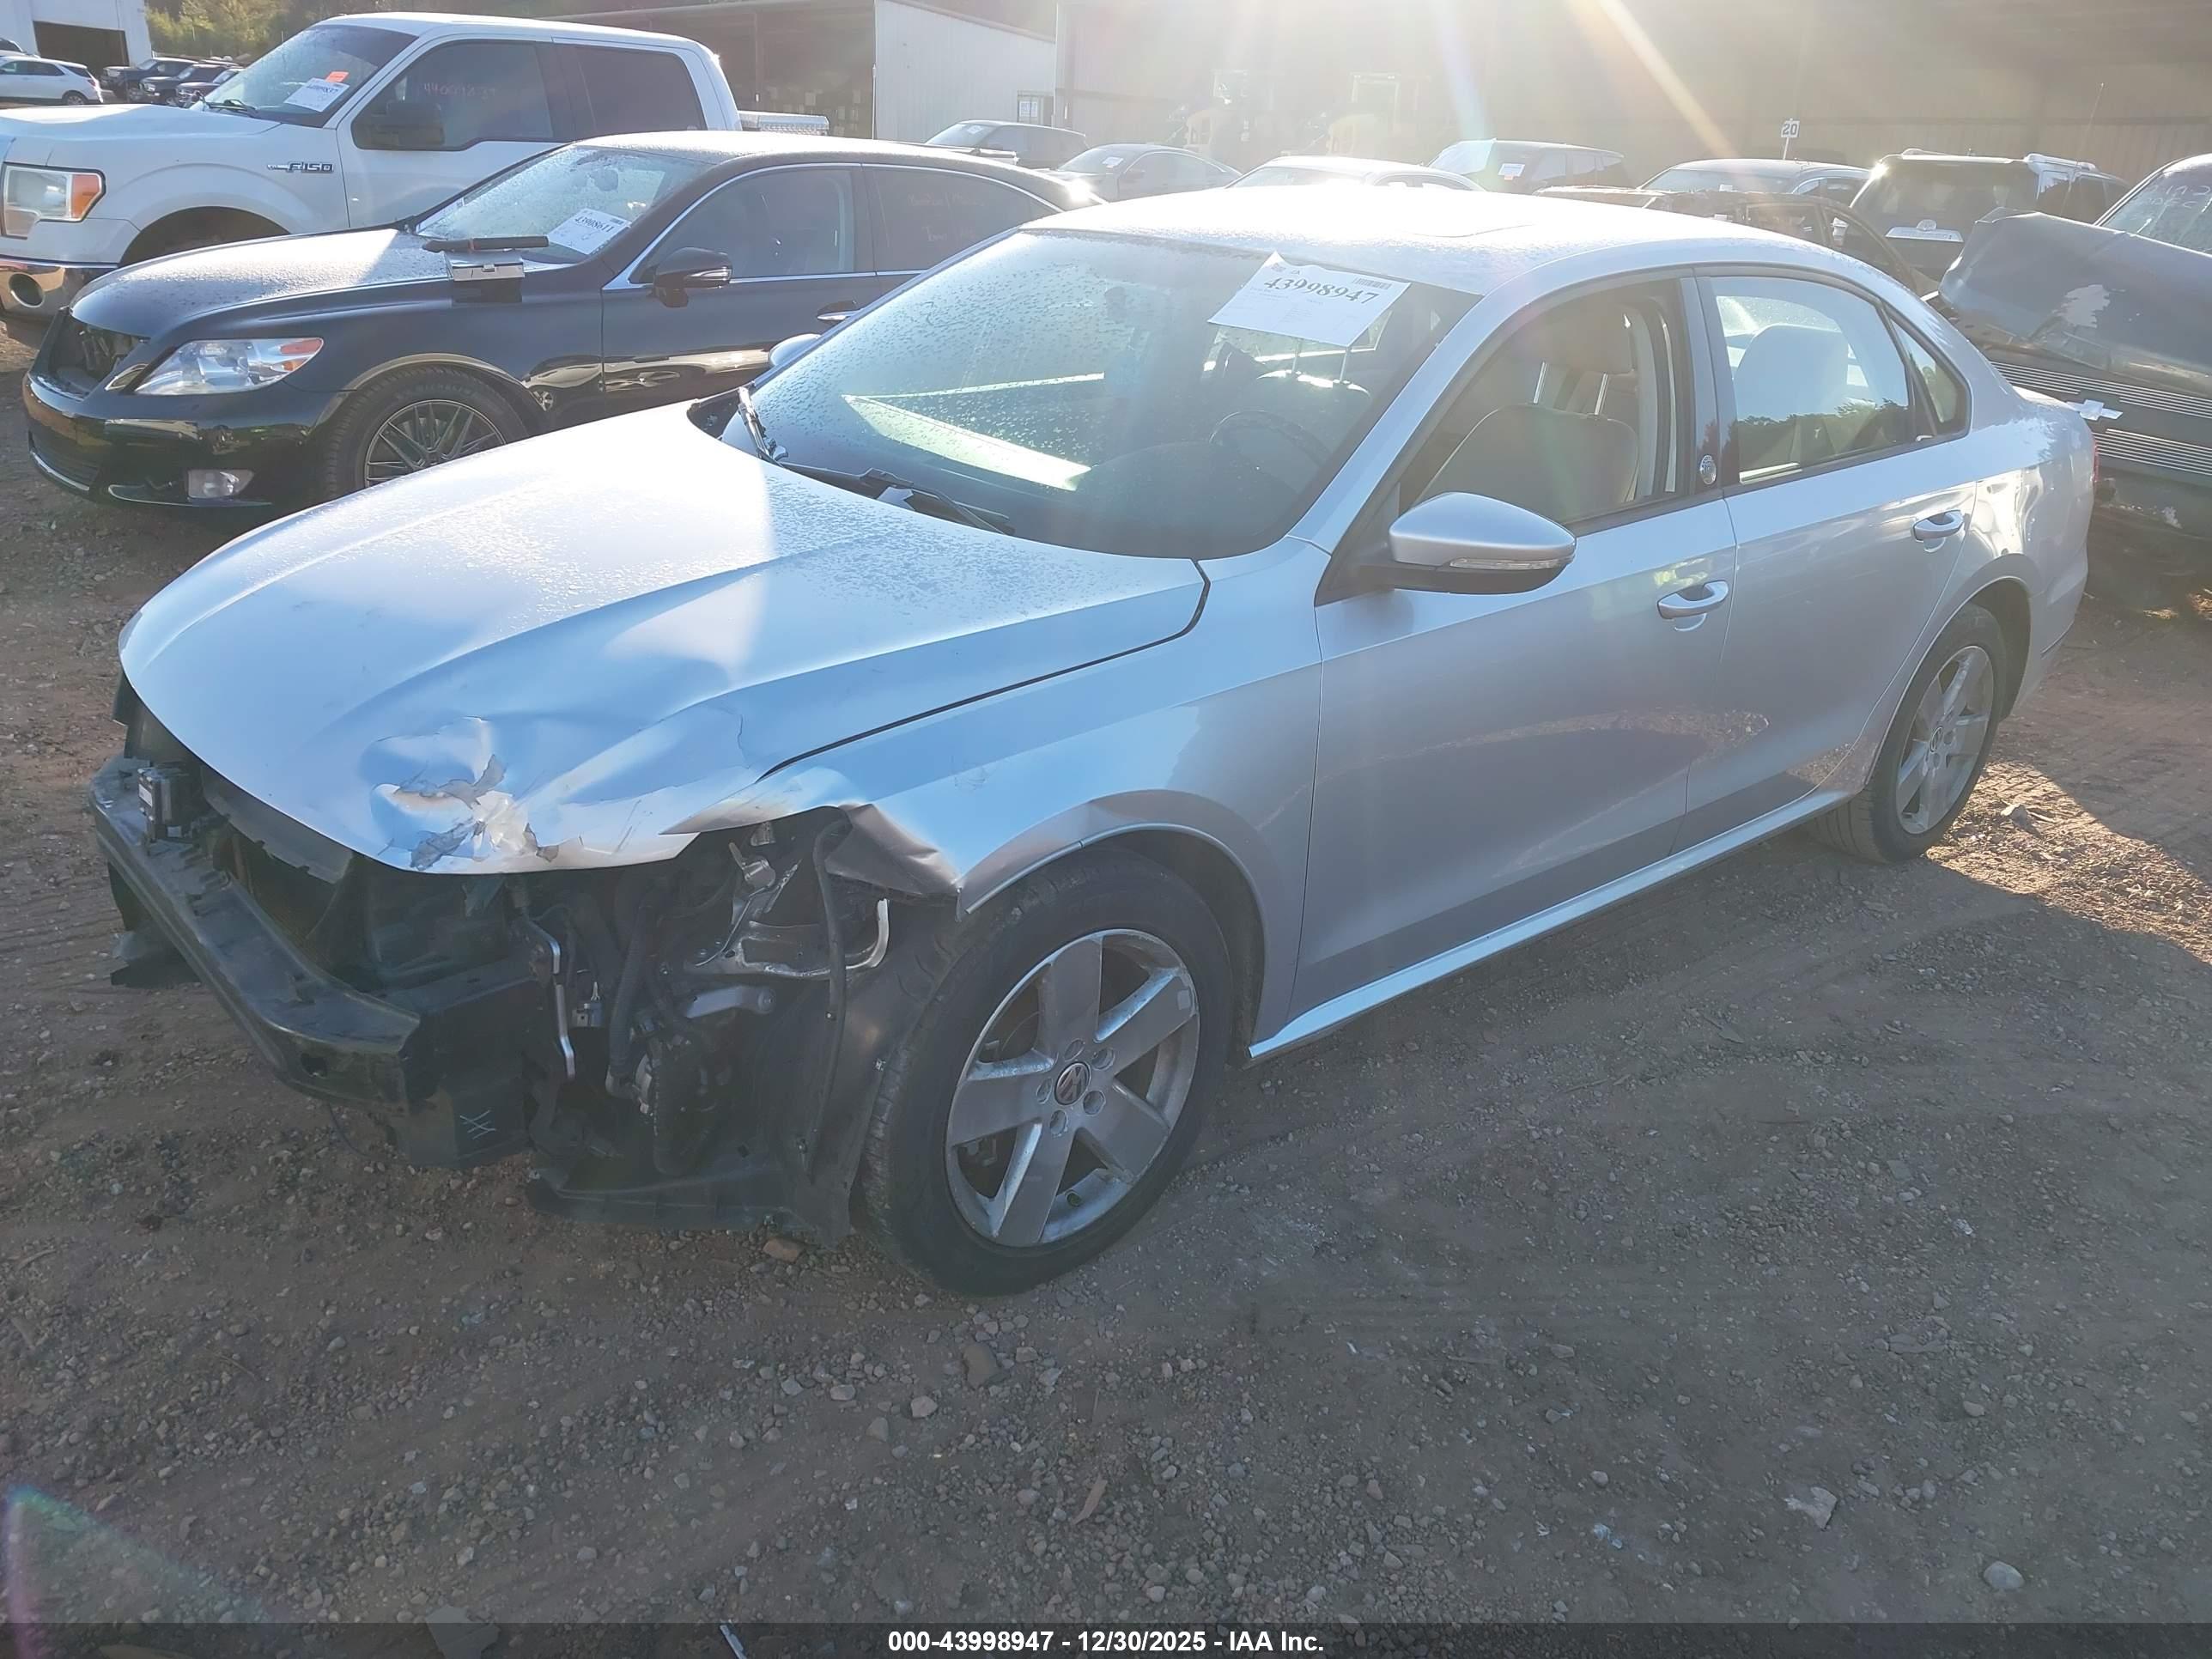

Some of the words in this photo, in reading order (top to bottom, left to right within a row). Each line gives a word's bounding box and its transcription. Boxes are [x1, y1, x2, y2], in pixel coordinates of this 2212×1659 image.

[1783, 124, 1798, 136] 20
[574, 216, 616, 233] 43908611
[1263, 276, 1380, 305] 43998947
